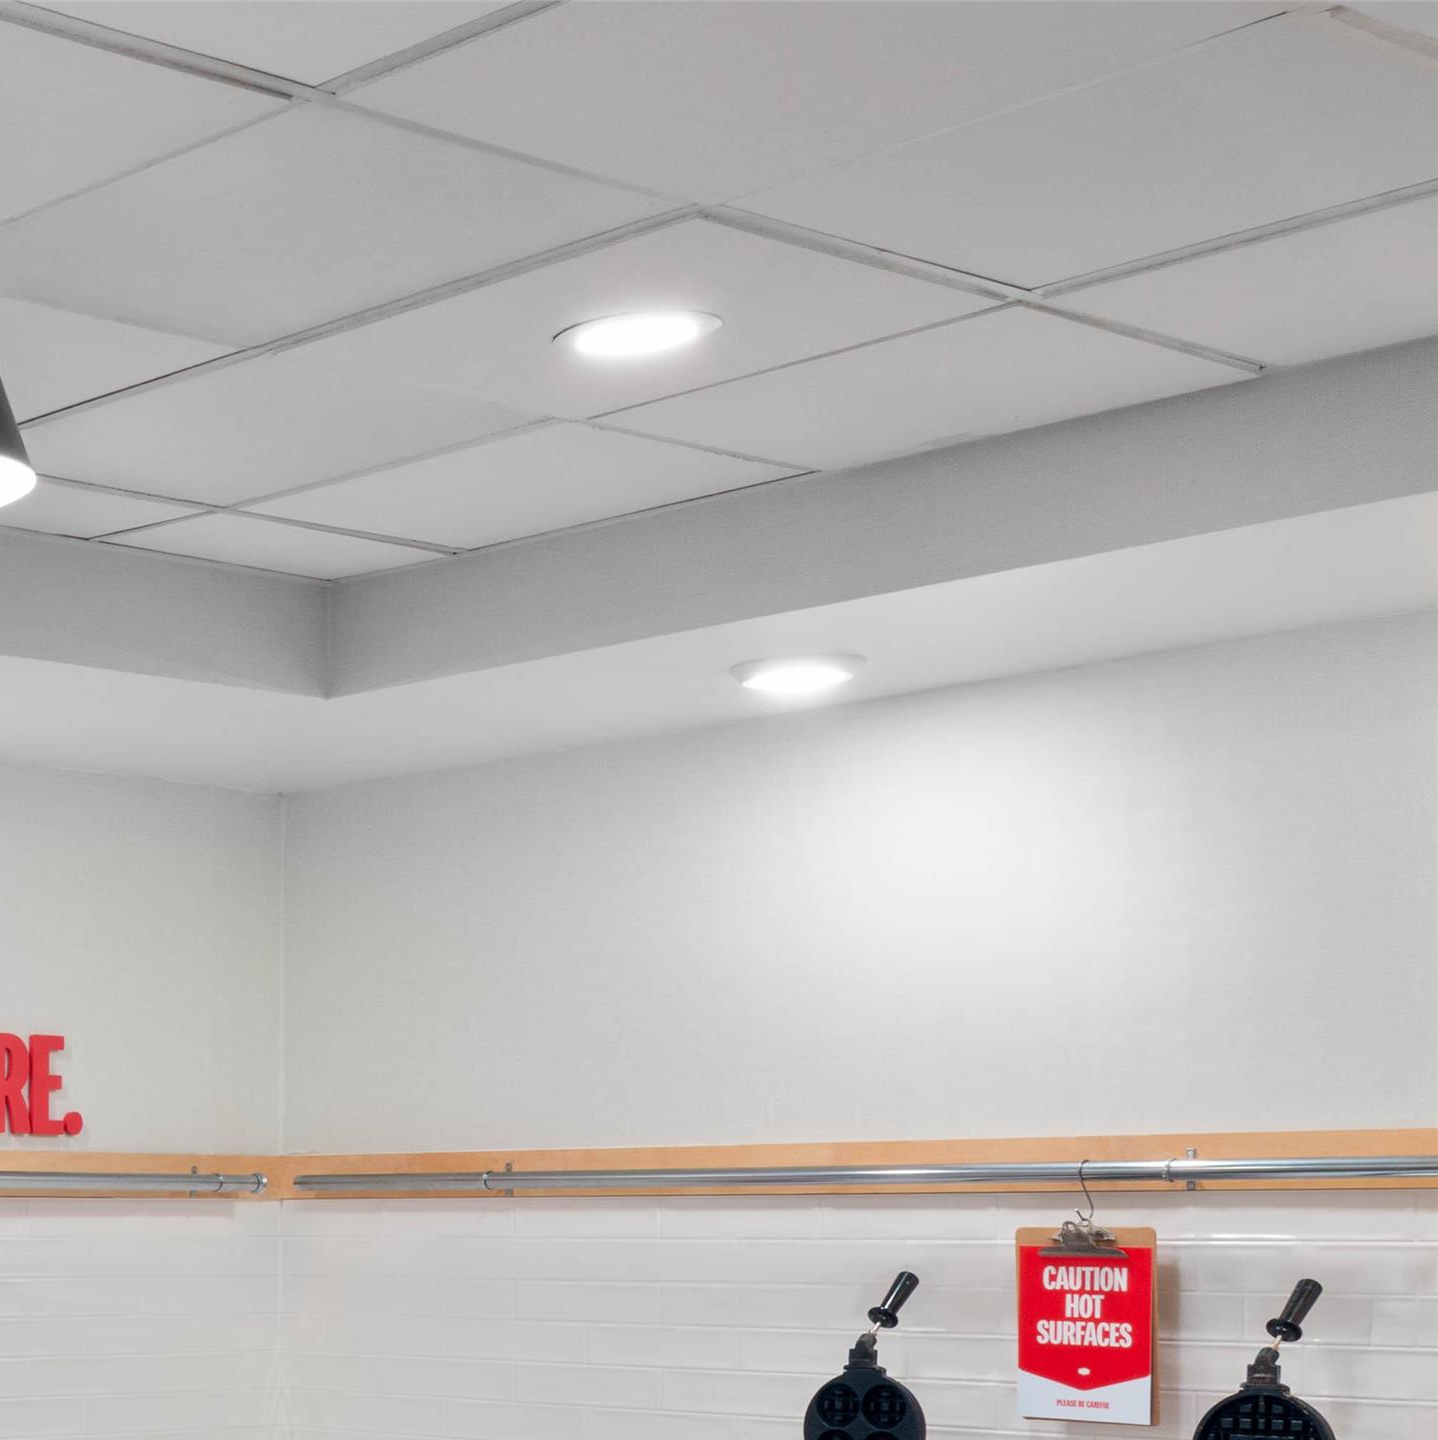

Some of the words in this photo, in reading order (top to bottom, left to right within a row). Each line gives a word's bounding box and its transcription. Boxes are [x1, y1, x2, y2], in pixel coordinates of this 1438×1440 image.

[1042, 1265, 1128, 1292] CAUTION
[1065, 1294, 1104, 1319] HOT
[1036, 1320, 1133, 1348] SURFACES
[1056, 1399, 1076, 1407] PLEASE
